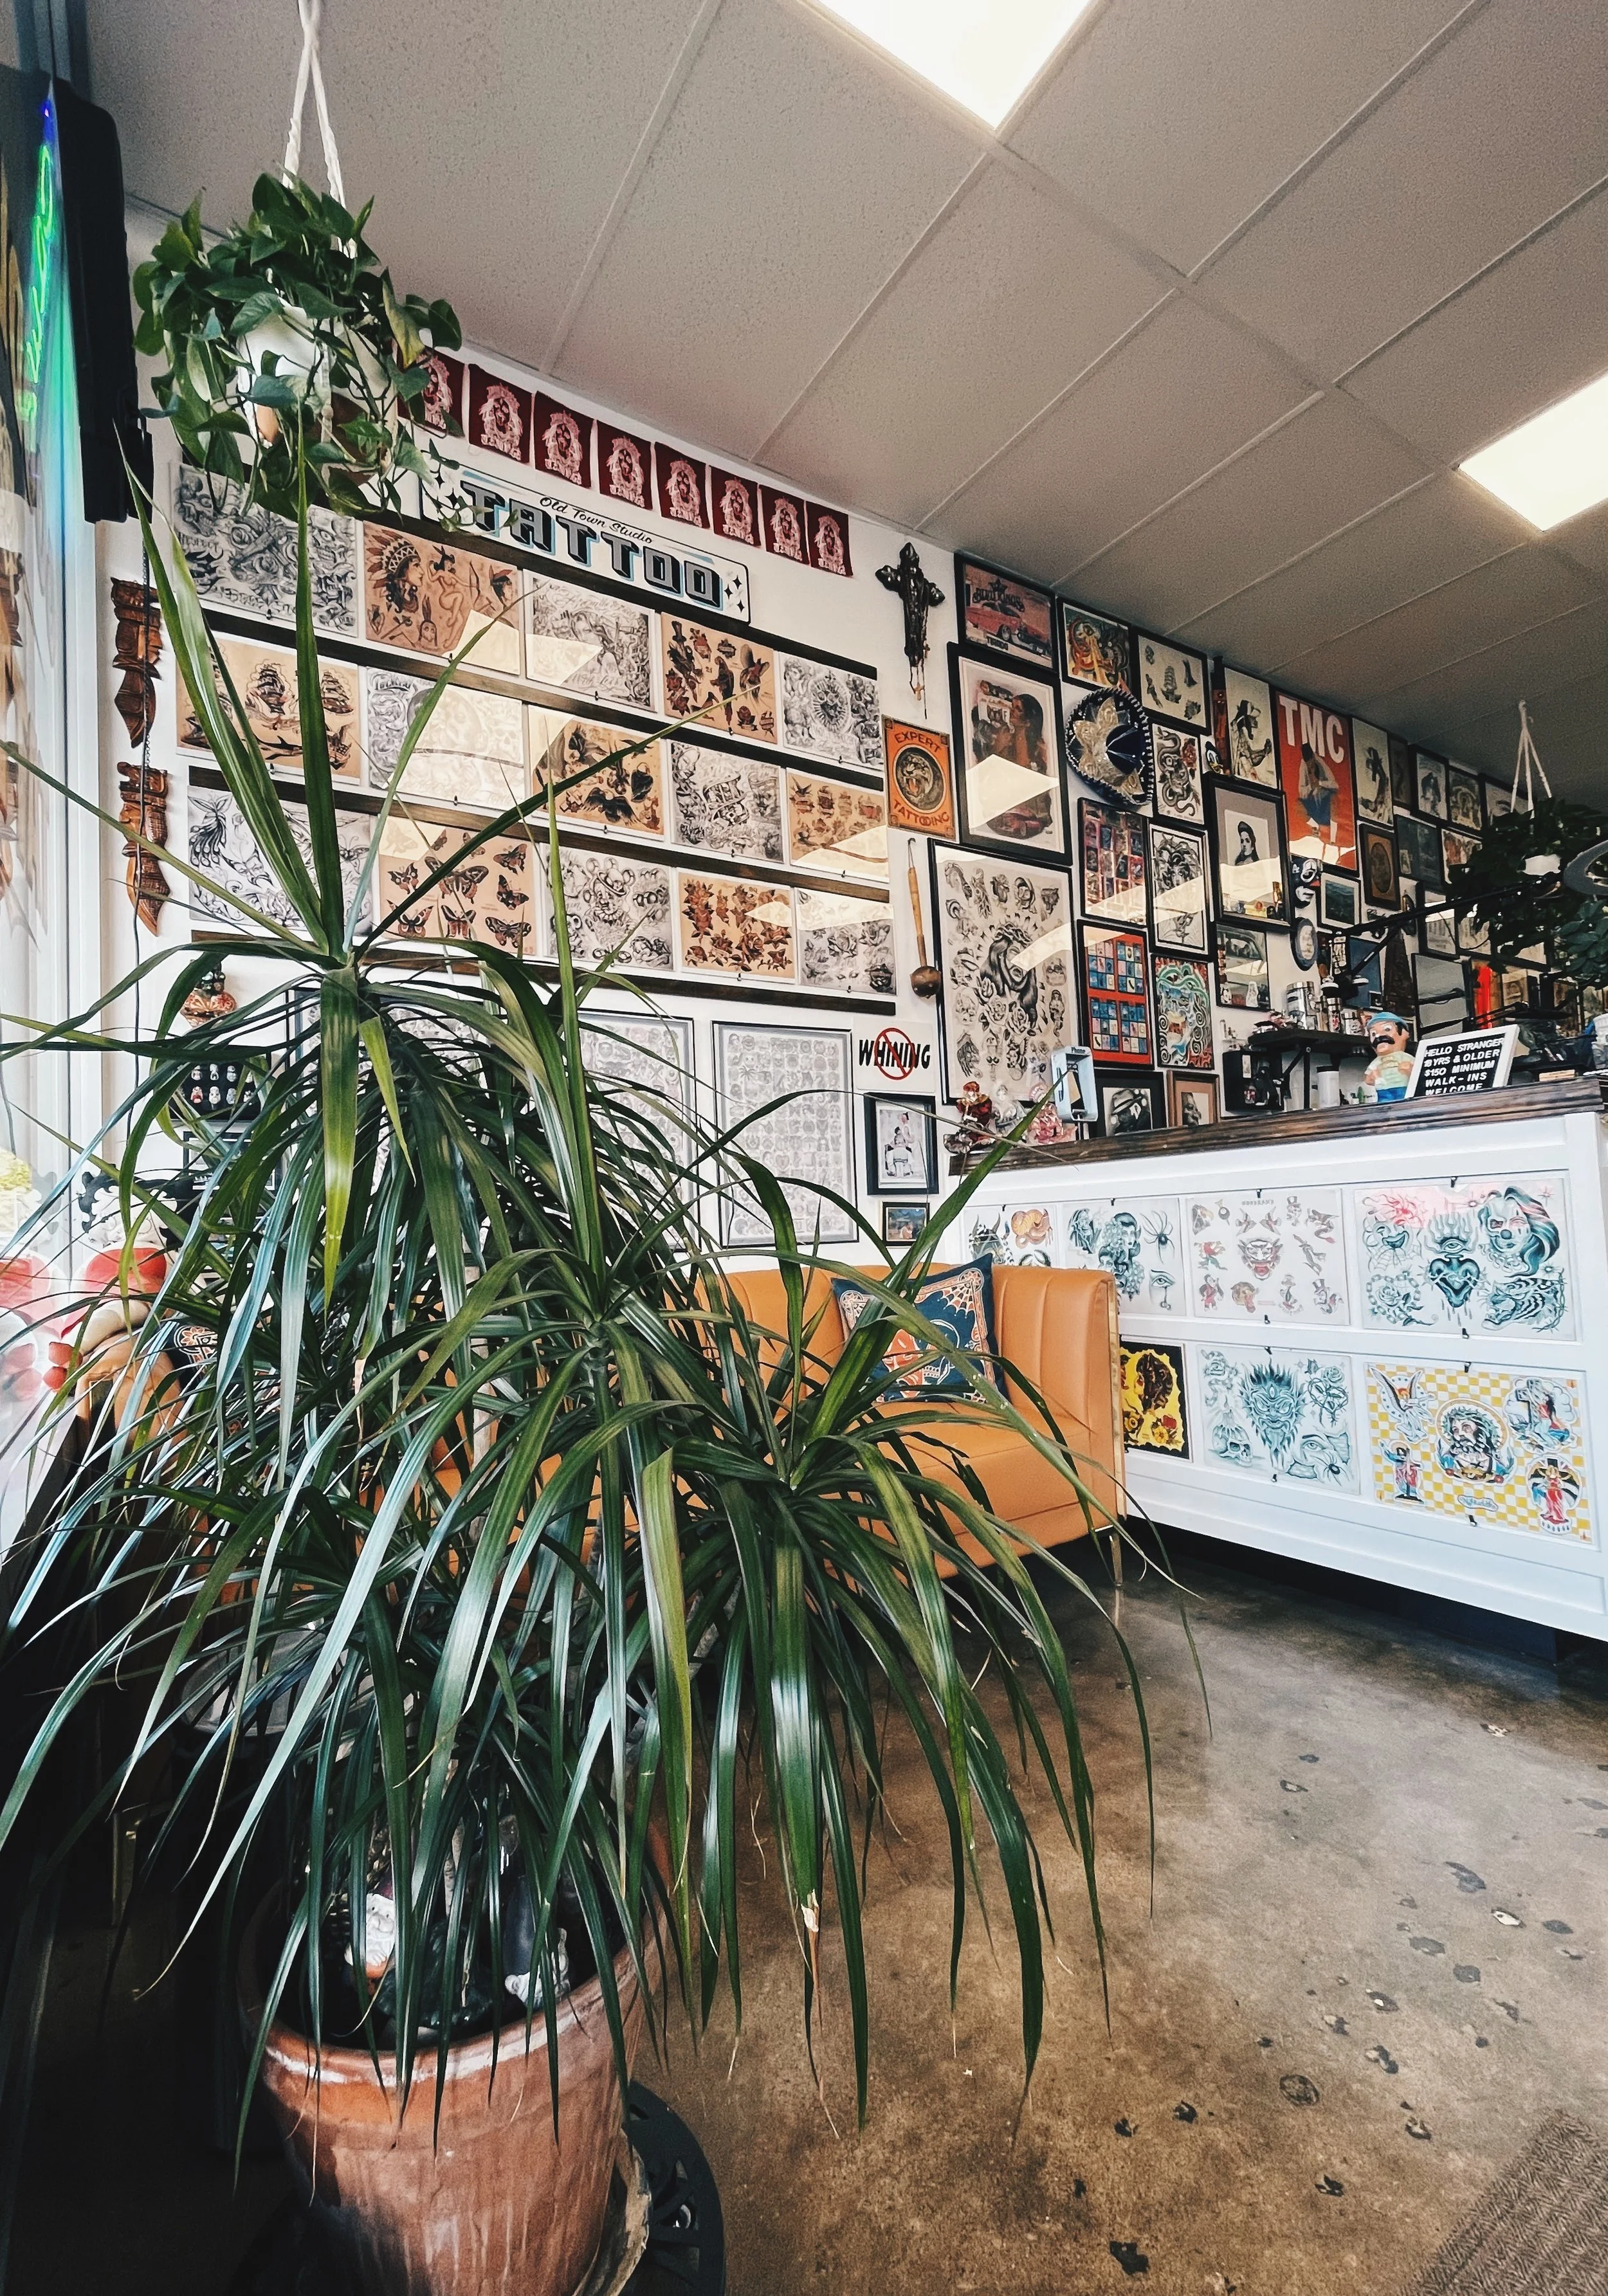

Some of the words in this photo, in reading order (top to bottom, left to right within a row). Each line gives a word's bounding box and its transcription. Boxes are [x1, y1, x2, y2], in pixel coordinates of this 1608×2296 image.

[539, 496, 567, 515] Old
[573, 507, 605, 527] Town
[609, 520, 653, 544] Studio
[460, 480, 724, 610] TATTOO
[1279, 695, 1344, 763] TMC
[895, 731, 942, 753] EXPERT
[894, 799, 950, 826] TATTOOING
[859, 1039, 930, 1069] WHINING
[1425, 1046, 1452, 1057] HELLO
[1457, 1037, 1504, 1053] STRANGER
[1463, 1049, 1500, 1062] OLDER
[1424, 1068, 1447, 1077] $150
[1452, 1060, 1495, 1073] MINIMUM
[1425, 1083, 1483, 1096] WELCOME
